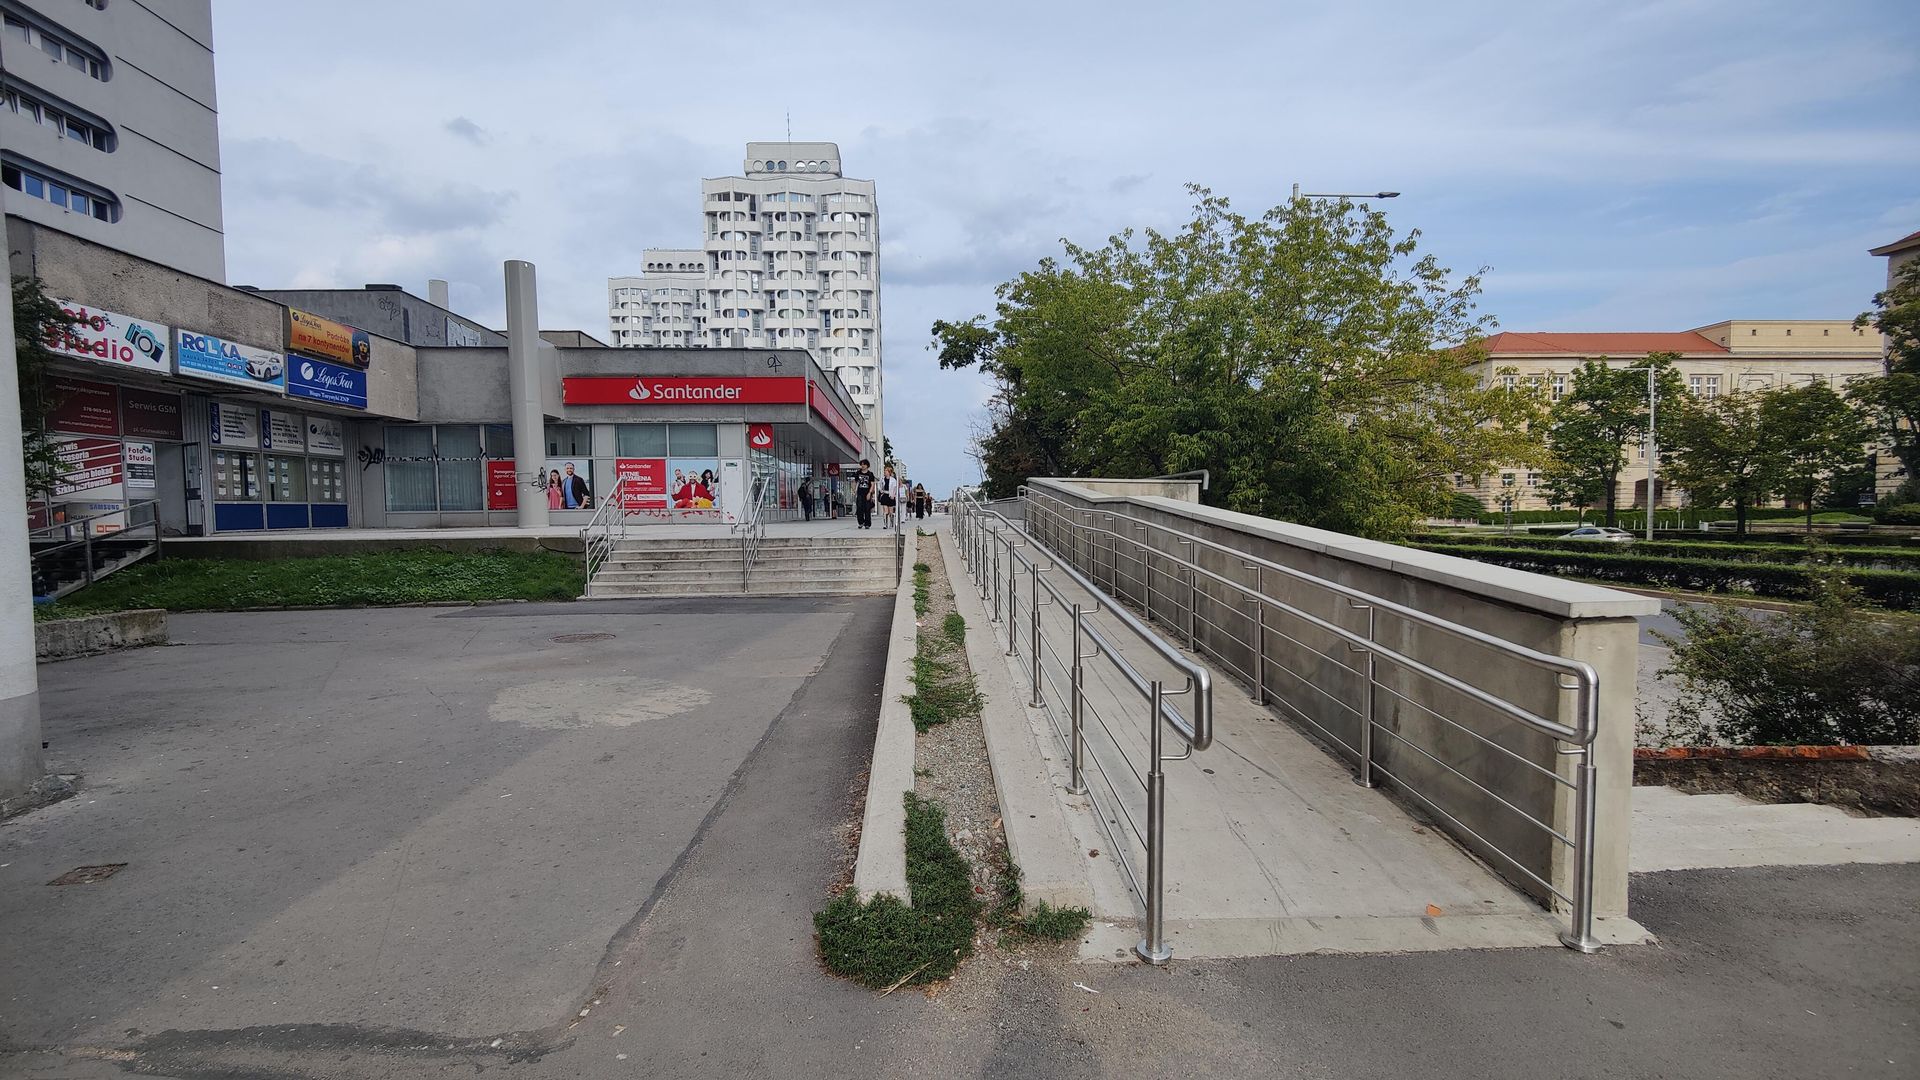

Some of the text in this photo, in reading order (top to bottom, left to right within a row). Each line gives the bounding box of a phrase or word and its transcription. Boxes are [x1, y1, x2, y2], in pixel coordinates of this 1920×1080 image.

[182, 332, 242, 360] ROLKA
[298, 334, 306, 342] na
[313, 336, 351, 354] kontynentów
[326, 331, 350, 344] Podróże
[314, 366, 353, 389] Logos Tour
[653, 383, 742, 400] Santander
[128, 400, 177, 415] Serwis GSM
[128, 454, 152, 462] Studio
